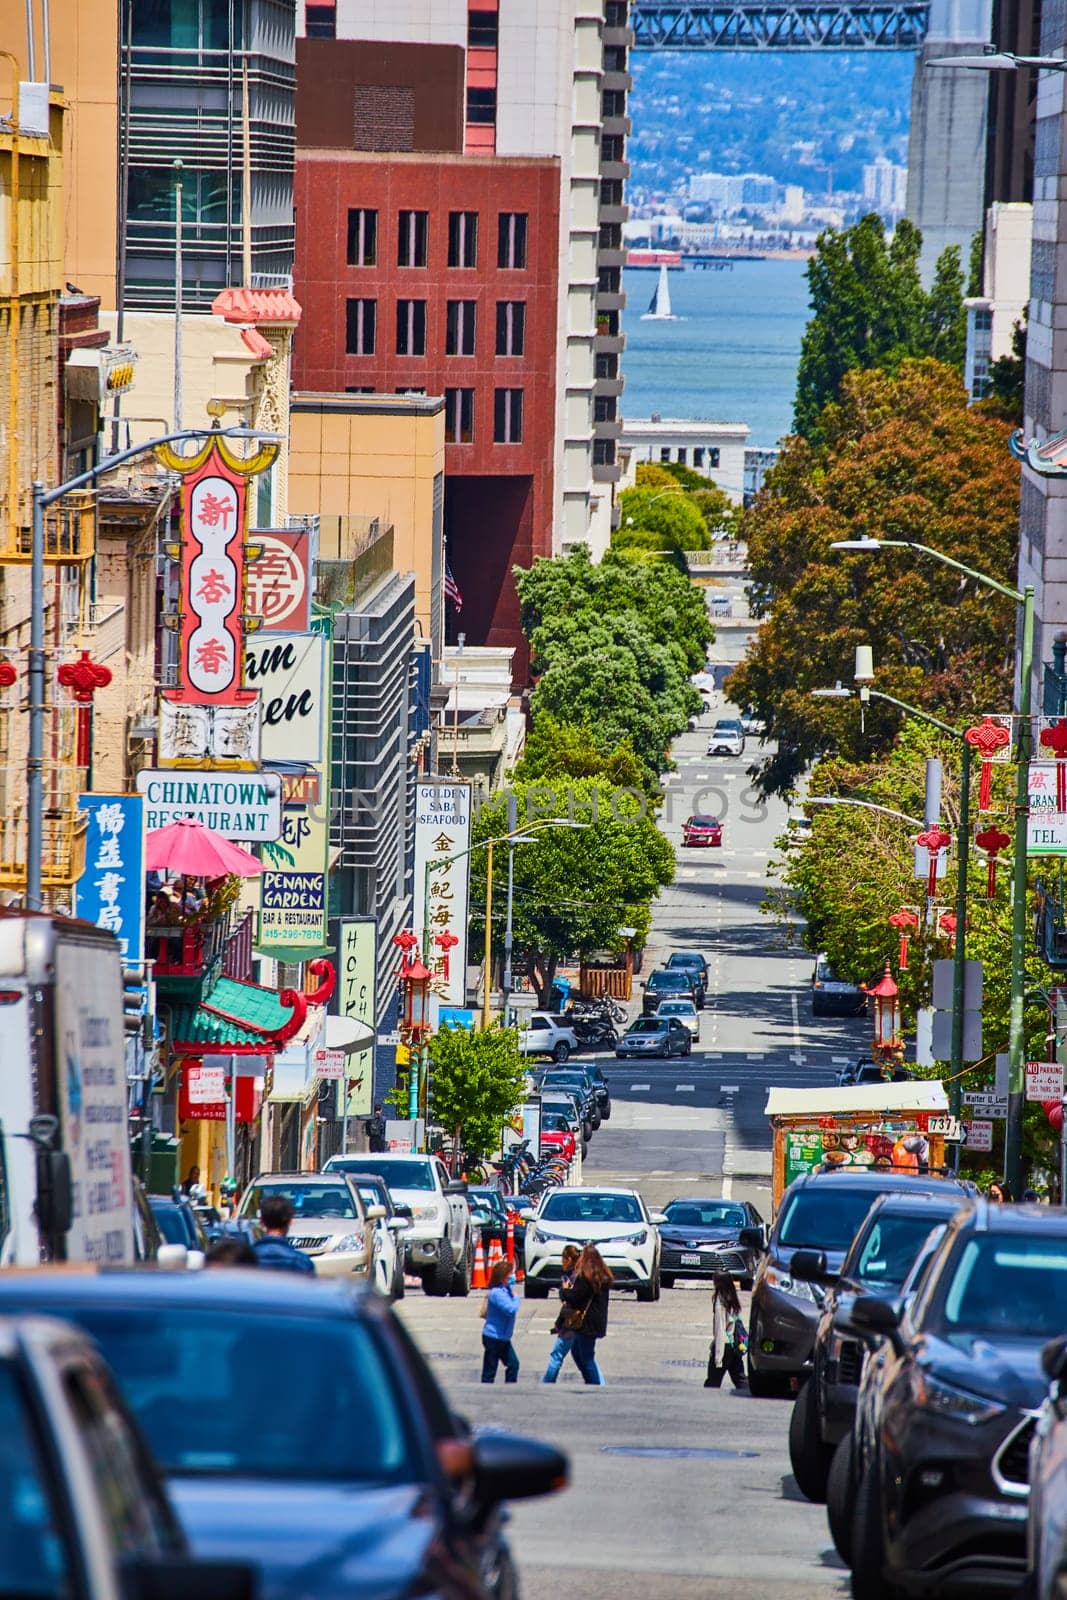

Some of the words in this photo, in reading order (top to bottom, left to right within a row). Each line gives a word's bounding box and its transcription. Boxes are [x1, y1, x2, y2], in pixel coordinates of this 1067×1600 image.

[194, 493, 235, 675] 新杏香
[147, 781, 269, 806] CHINATOWN
[421, 787, 466, 799] GOLDEN
[429, 801, 457, 812] SABA
[420, 815, 466, 825] SEAFOOD
[1033, 829, 1061, 843] TEL.
[264, 872, 323, 891] PENANG
[264, 890, 322, 908] GARDEN
[263, 912, 275, 925] BAR
[284, 912, 323, 926] RESTAURANT
[1028, 1063, 1038, 1073] NO
[1040, 1066, 1063, 1074] PARKING
[929, 1118, 952, 1130] 737
